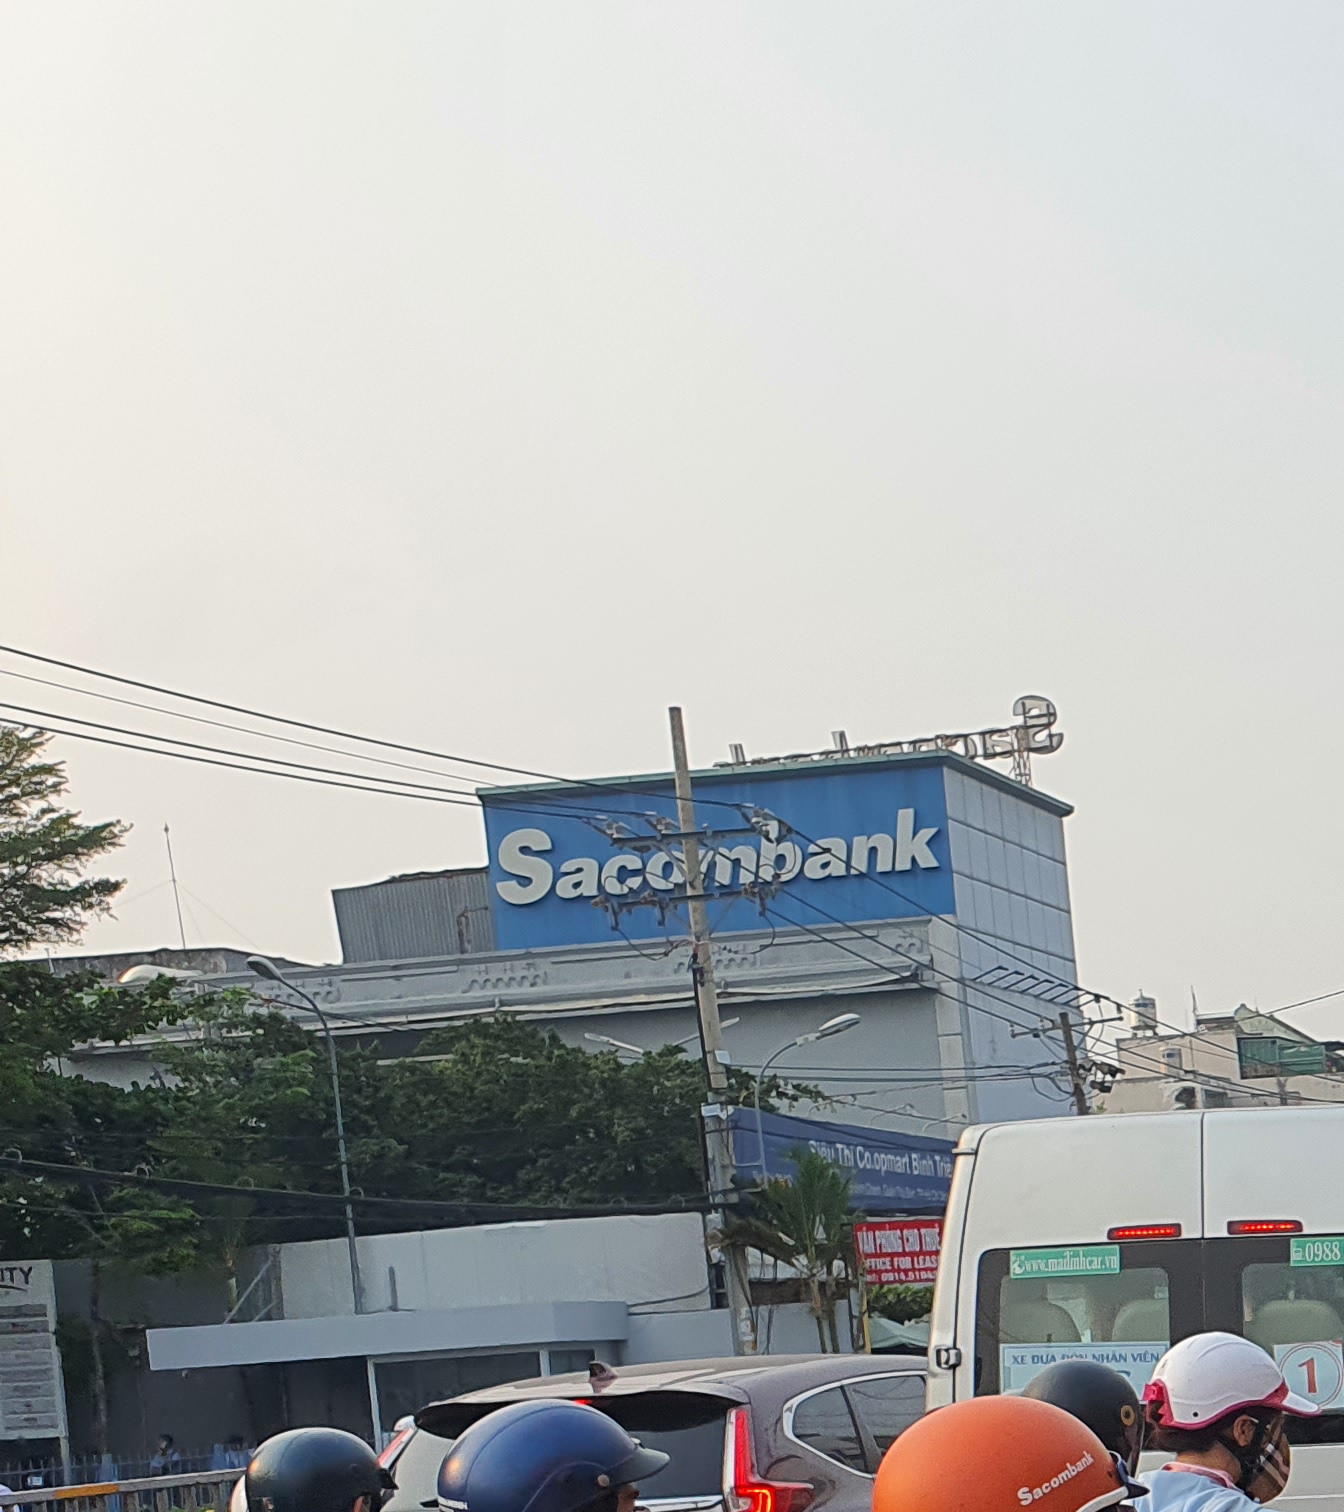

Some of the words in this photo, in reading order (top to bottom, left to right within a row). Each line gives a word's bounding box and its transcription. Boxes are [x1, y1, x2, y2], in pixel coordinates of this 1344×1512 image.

[495, 808, 941, 905] Sacombank
[856, 1146, 911, 1177] Co.opmart
[1305, 1241, 1341, 1262] 0988
[1012, 1354, 1027, 1365] XE
[1130, 1349, 1160, 1364] VIÊN
[1298, 1357, 1317, 1394] 1
[1017, 1450, 1095, 1506] Sacombank
